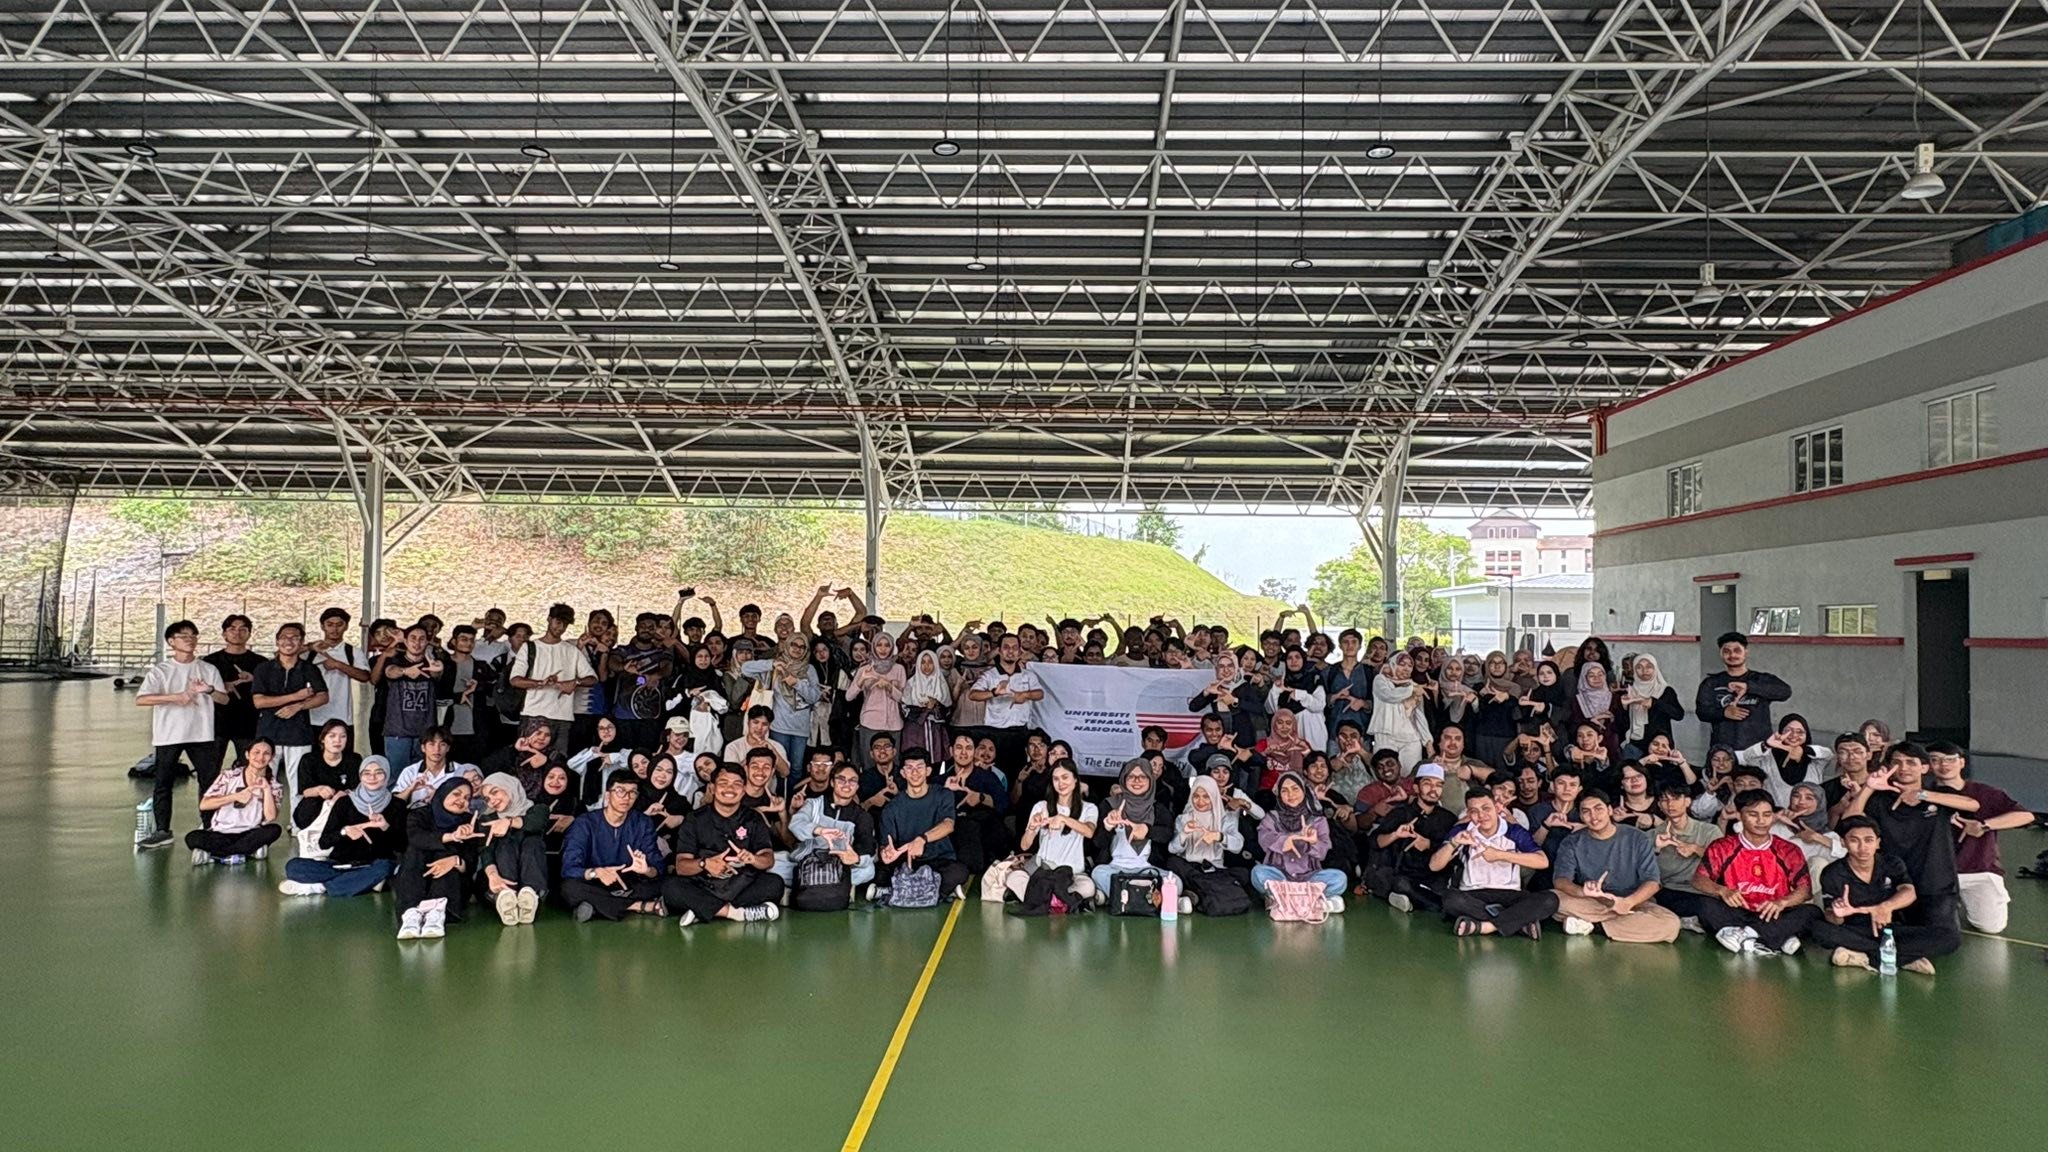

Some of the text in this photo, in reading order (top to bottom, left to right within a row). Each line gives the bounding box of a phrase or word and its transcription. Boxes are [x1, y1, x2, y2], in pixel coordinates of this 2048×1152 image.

[402, 690, 428, 711] 24
[1064, 710, 1131, 718] UNIVERSITI
[1085, 757, 1102, 767] The
